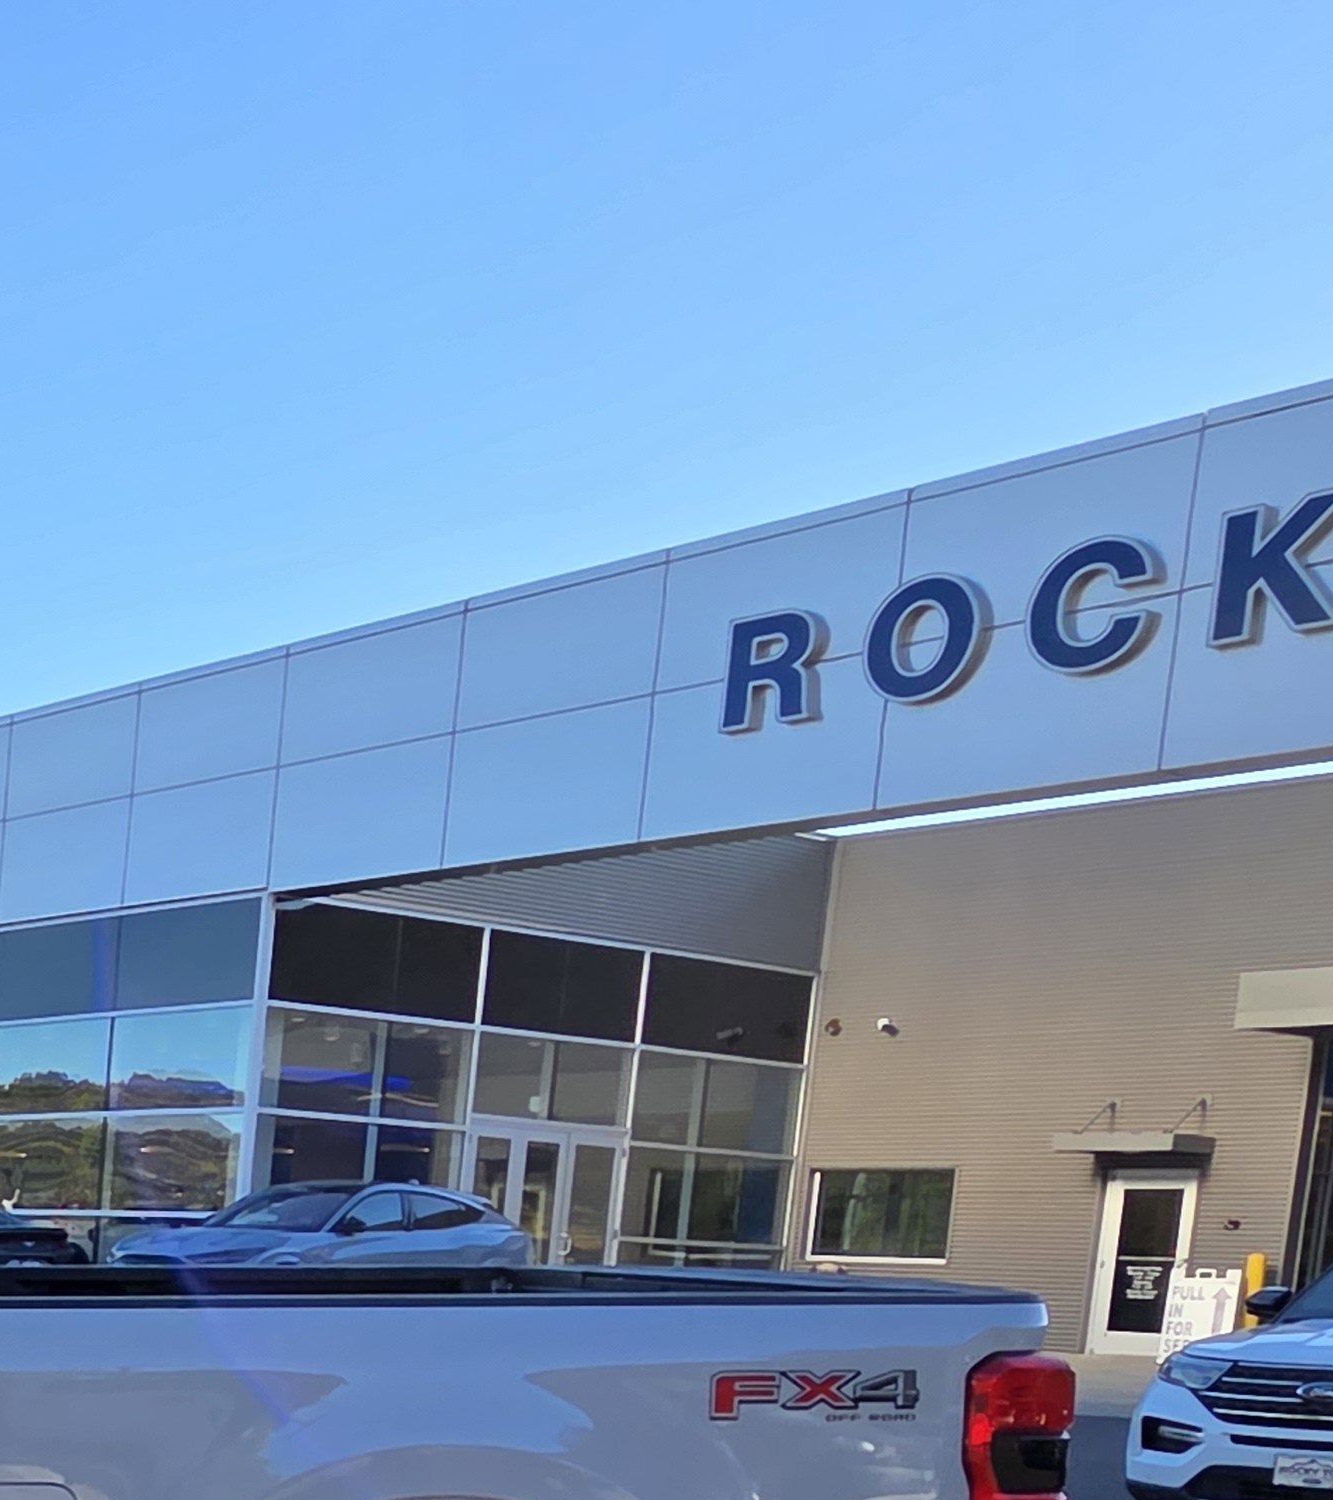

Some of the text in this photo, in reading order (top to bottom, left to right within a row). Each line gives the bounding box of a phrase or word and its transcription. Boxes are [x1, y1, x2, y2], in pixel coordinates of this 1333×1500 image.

[718, 487, 1333, 734] ROCK
[1172, 1285, 1206, 1302] PULL
[1168, 1303, 1184, 1318] IN
[1165, 1320, 1194, 1337] FOR
[709, 1369, 920, 1421] FX4
[825, 1412, 918, 1422] OFF ROAD
